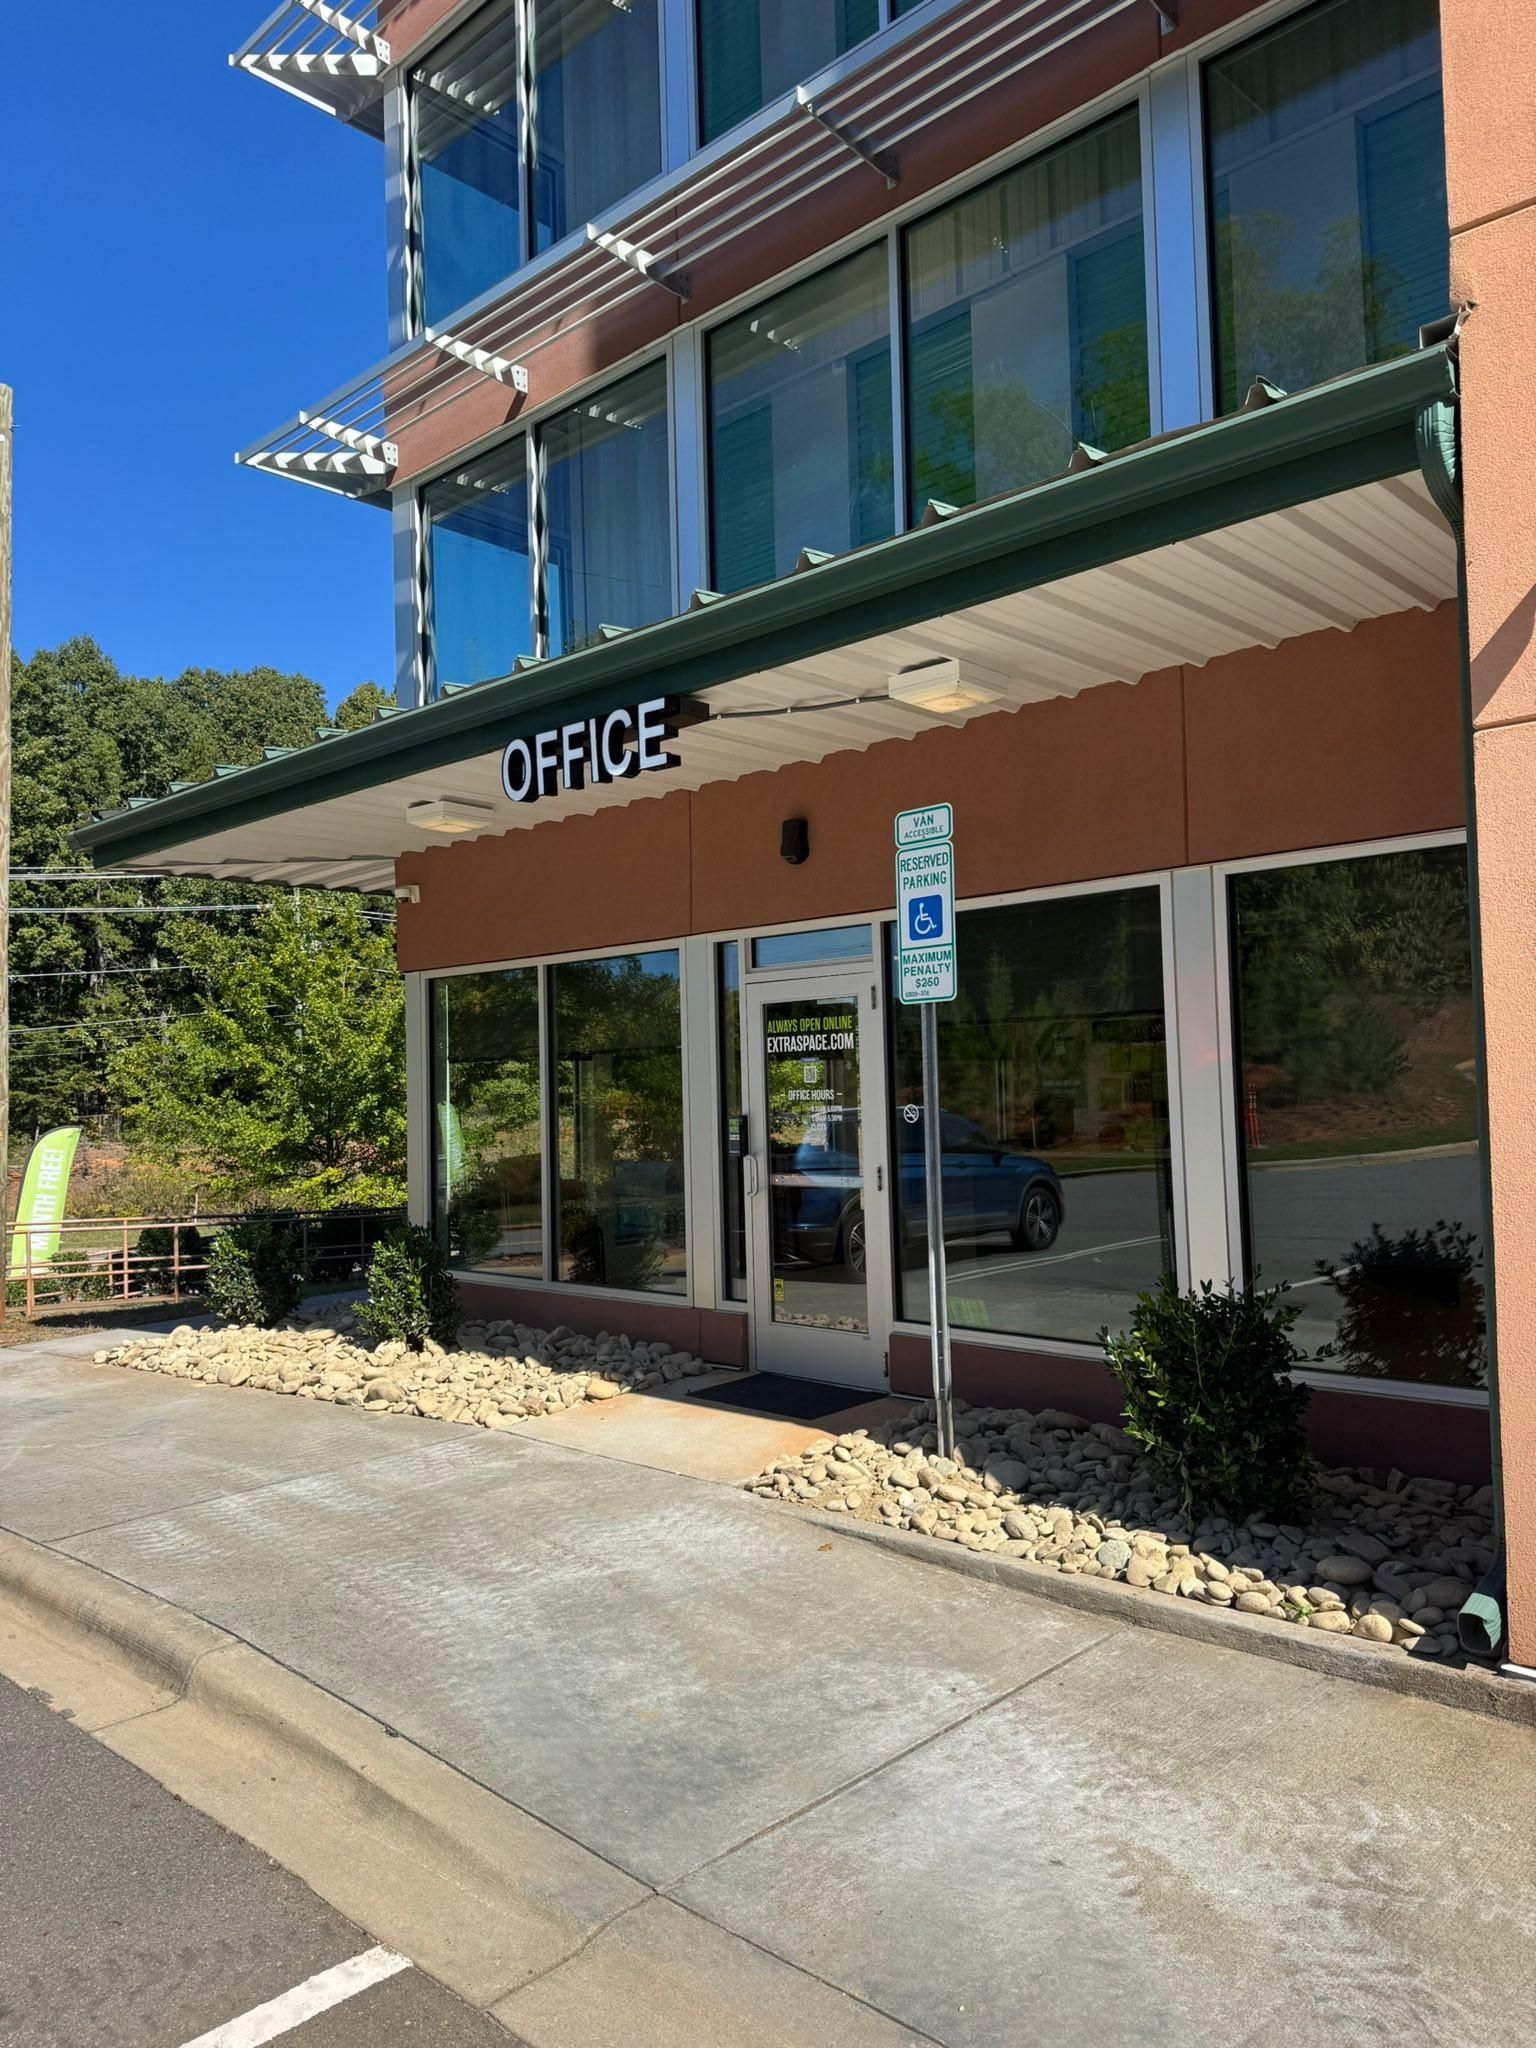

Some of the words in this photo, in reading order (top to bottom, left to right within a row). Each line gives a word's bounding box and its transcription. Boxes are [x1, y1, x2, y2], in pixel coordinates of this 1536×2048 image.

[501, 696, 669, 802] OFFICE
[912, 813, 934, 828] VAN
[904, 825, 944, 840] ACCESSIBLE
[900, 851, 949, 872] RESERVED
[903, 870, 947, 890] PARKING
[903, 949, 952, 965] MAXIMUM
[904, 963, 951, 977] PENALTY
[915, 976, 940, 988] $250
[767, 1019, 798, 1033] ALWAYS
[799, 1017, 821, 1031] OPEN
[823, 1015, 853, 1030] ONLINE
[767, 1032, 854, 1053] EXTRASPACE.COM
[788, 1089, 811, 1101] OFFICE
[811, 1088, 835, 1101] HOURS
[37, 1148, 65, 1191] FREE!
